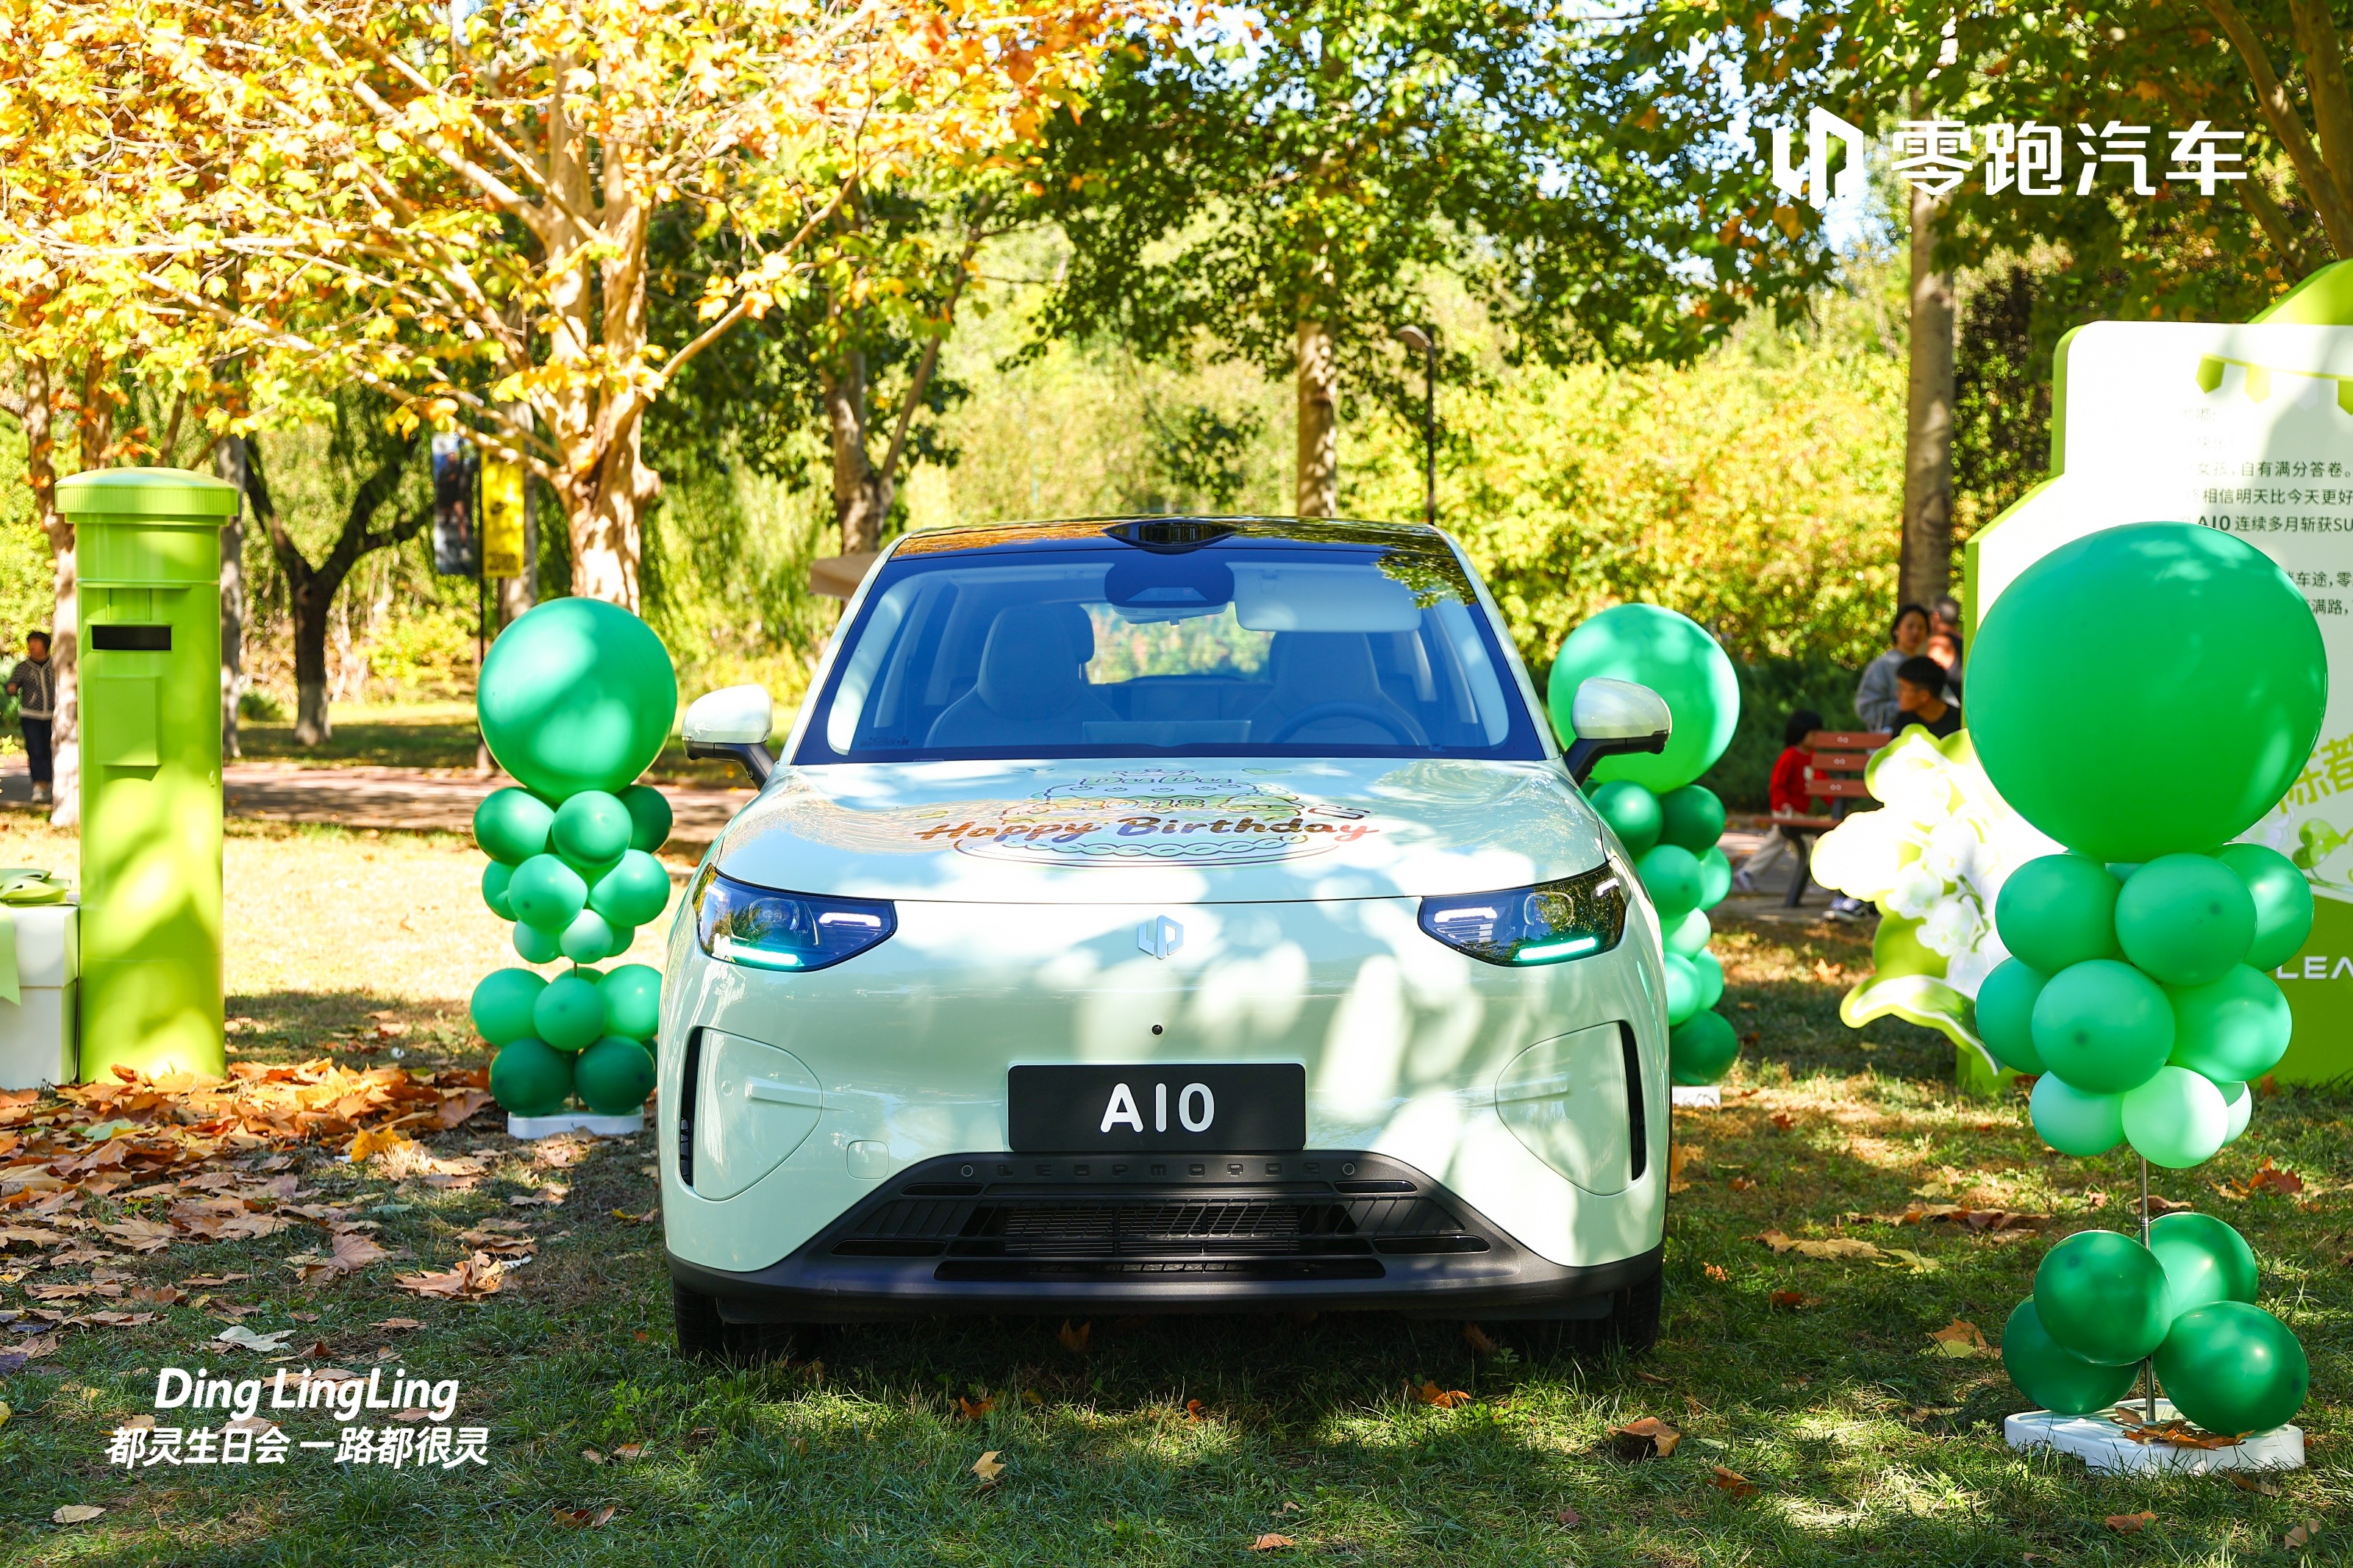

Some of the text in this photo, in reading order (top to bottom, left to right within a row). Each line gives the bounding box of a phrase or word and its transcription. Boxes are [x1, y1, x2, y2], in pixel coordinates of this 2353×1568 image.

[1082, 798, 1206, 810] 10.18
[914, 815, 1380, 842] Happy Birthday
[1100, 1083, 1215, 1133] A10
